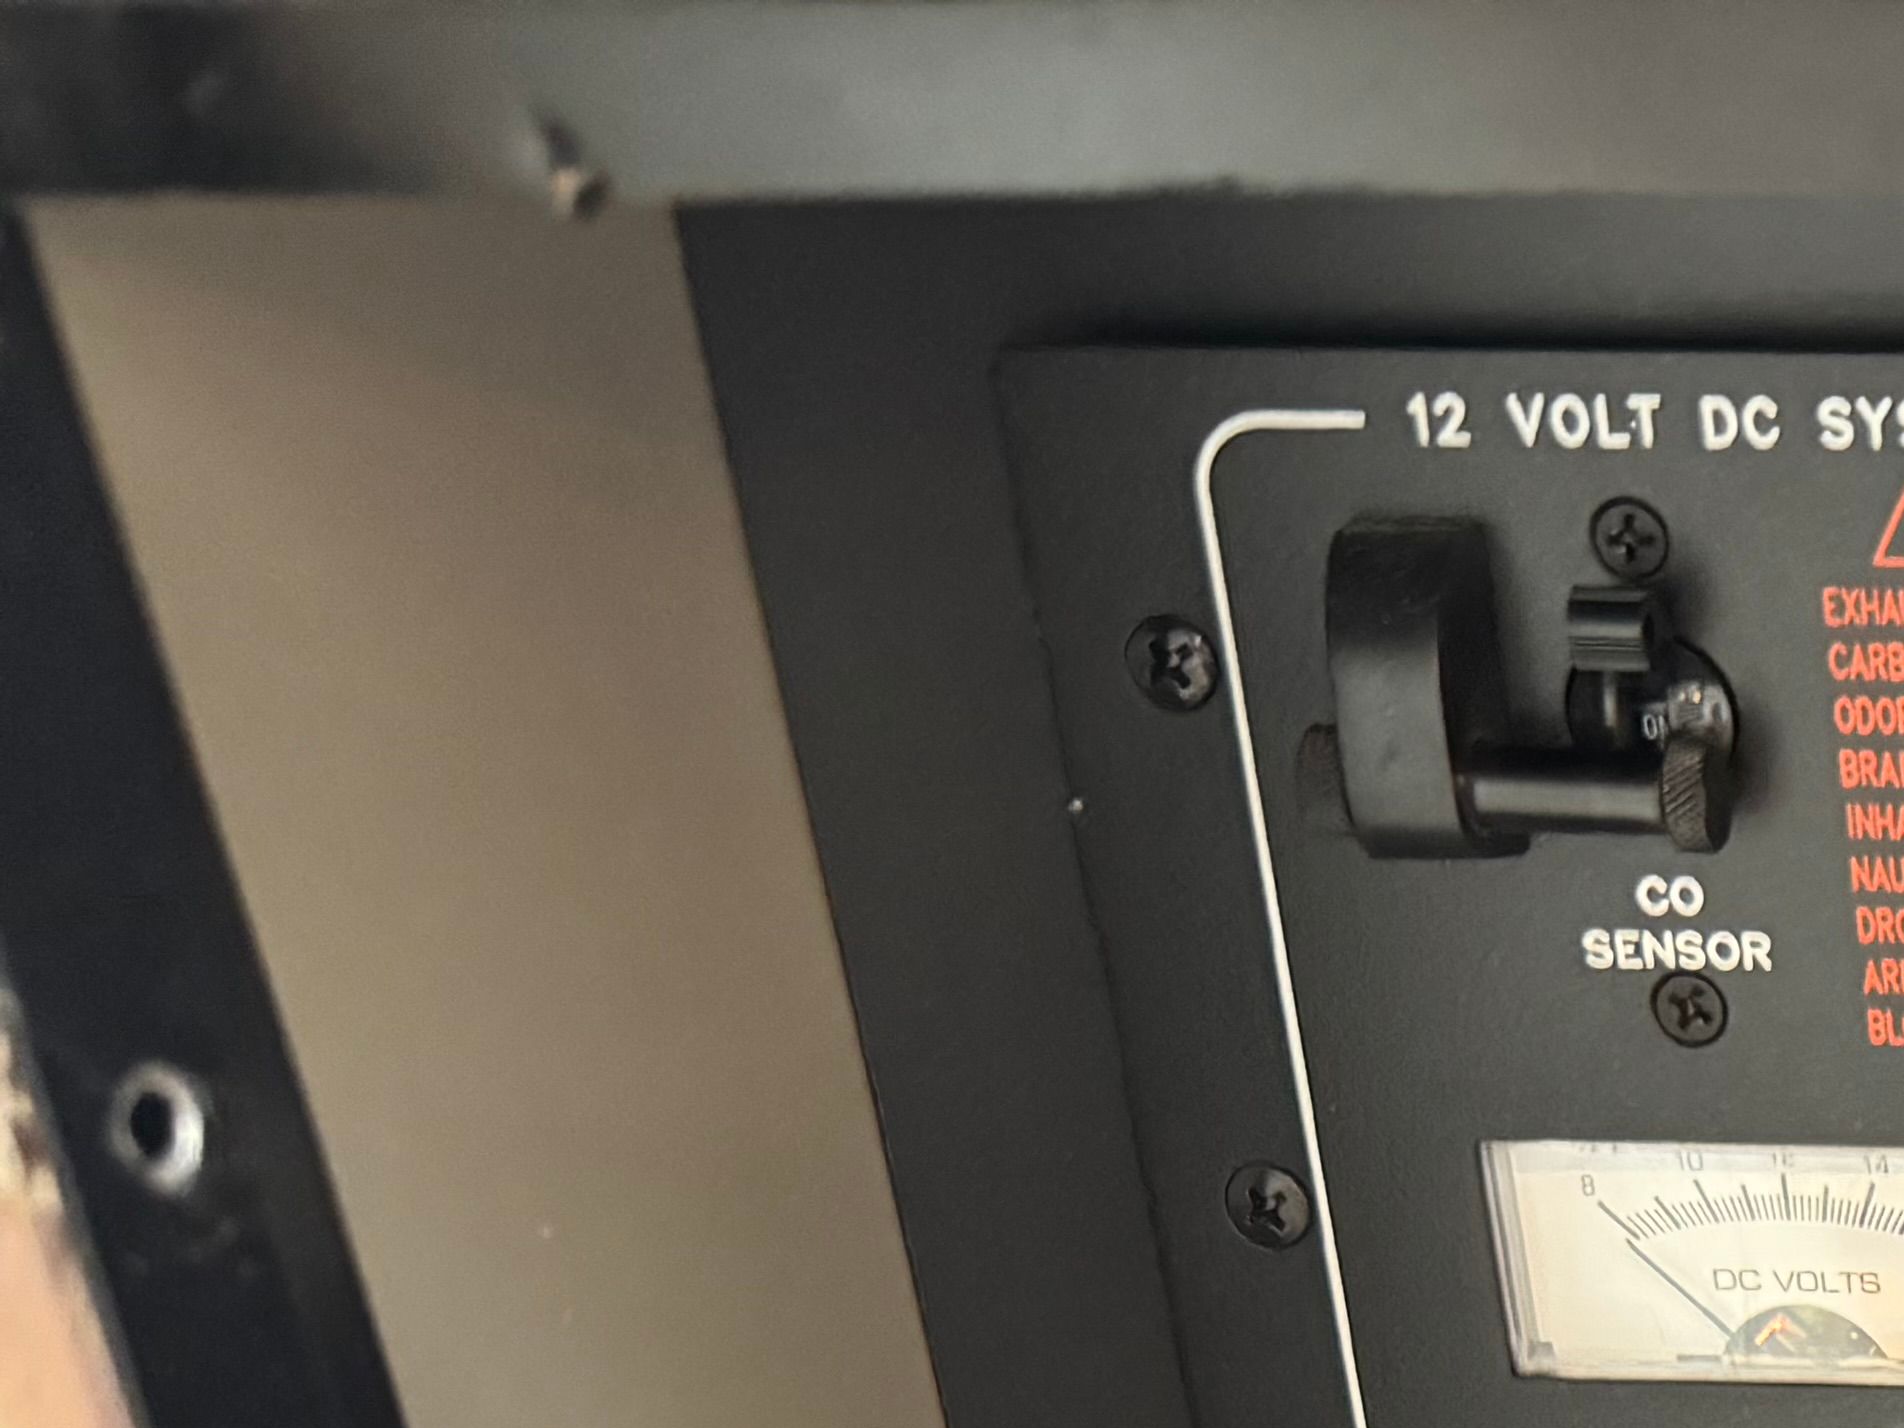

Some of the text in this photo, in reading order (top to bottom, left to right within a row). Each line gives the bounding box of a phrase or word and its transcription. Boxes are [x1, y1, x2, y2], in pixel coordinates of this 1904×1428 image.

[1405, 390, 1472, 448] 12
[1504, 391, 1662, 450] VOLT
[1697, 393, 1781, 452] DC
[1634, 873, 1705, 918] CO
[1580, 927, 1773, 972] SENSOR
[1581, 1173, 1595, 1198] 8
[1712, 1268, 1881, 1294] DC VOLTS
